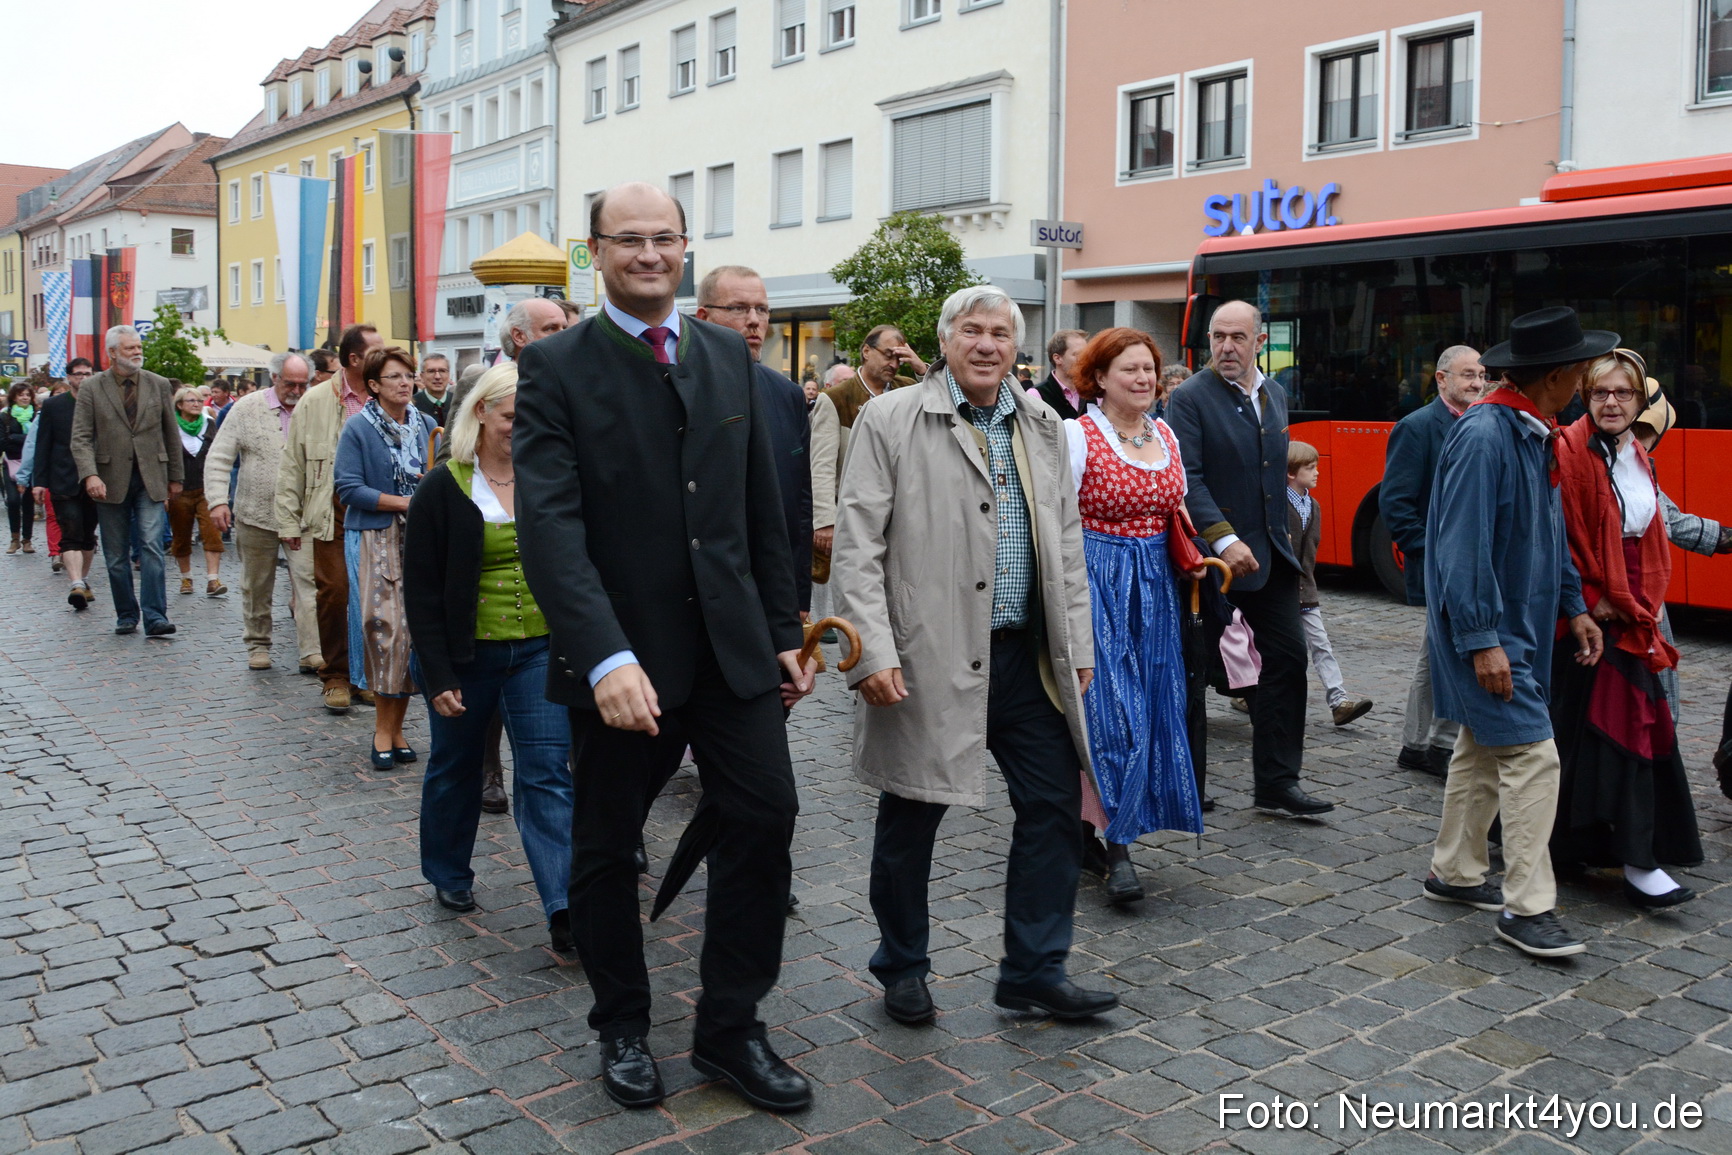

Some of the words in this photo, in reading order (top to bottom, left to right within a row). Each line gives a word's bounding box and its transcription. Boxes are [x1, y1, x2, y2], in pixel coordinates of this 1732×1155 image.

[1039, 225, 1082, 244] sutor.
[577, 250, 587, 264] H
[10, 341, 28, 355] R
